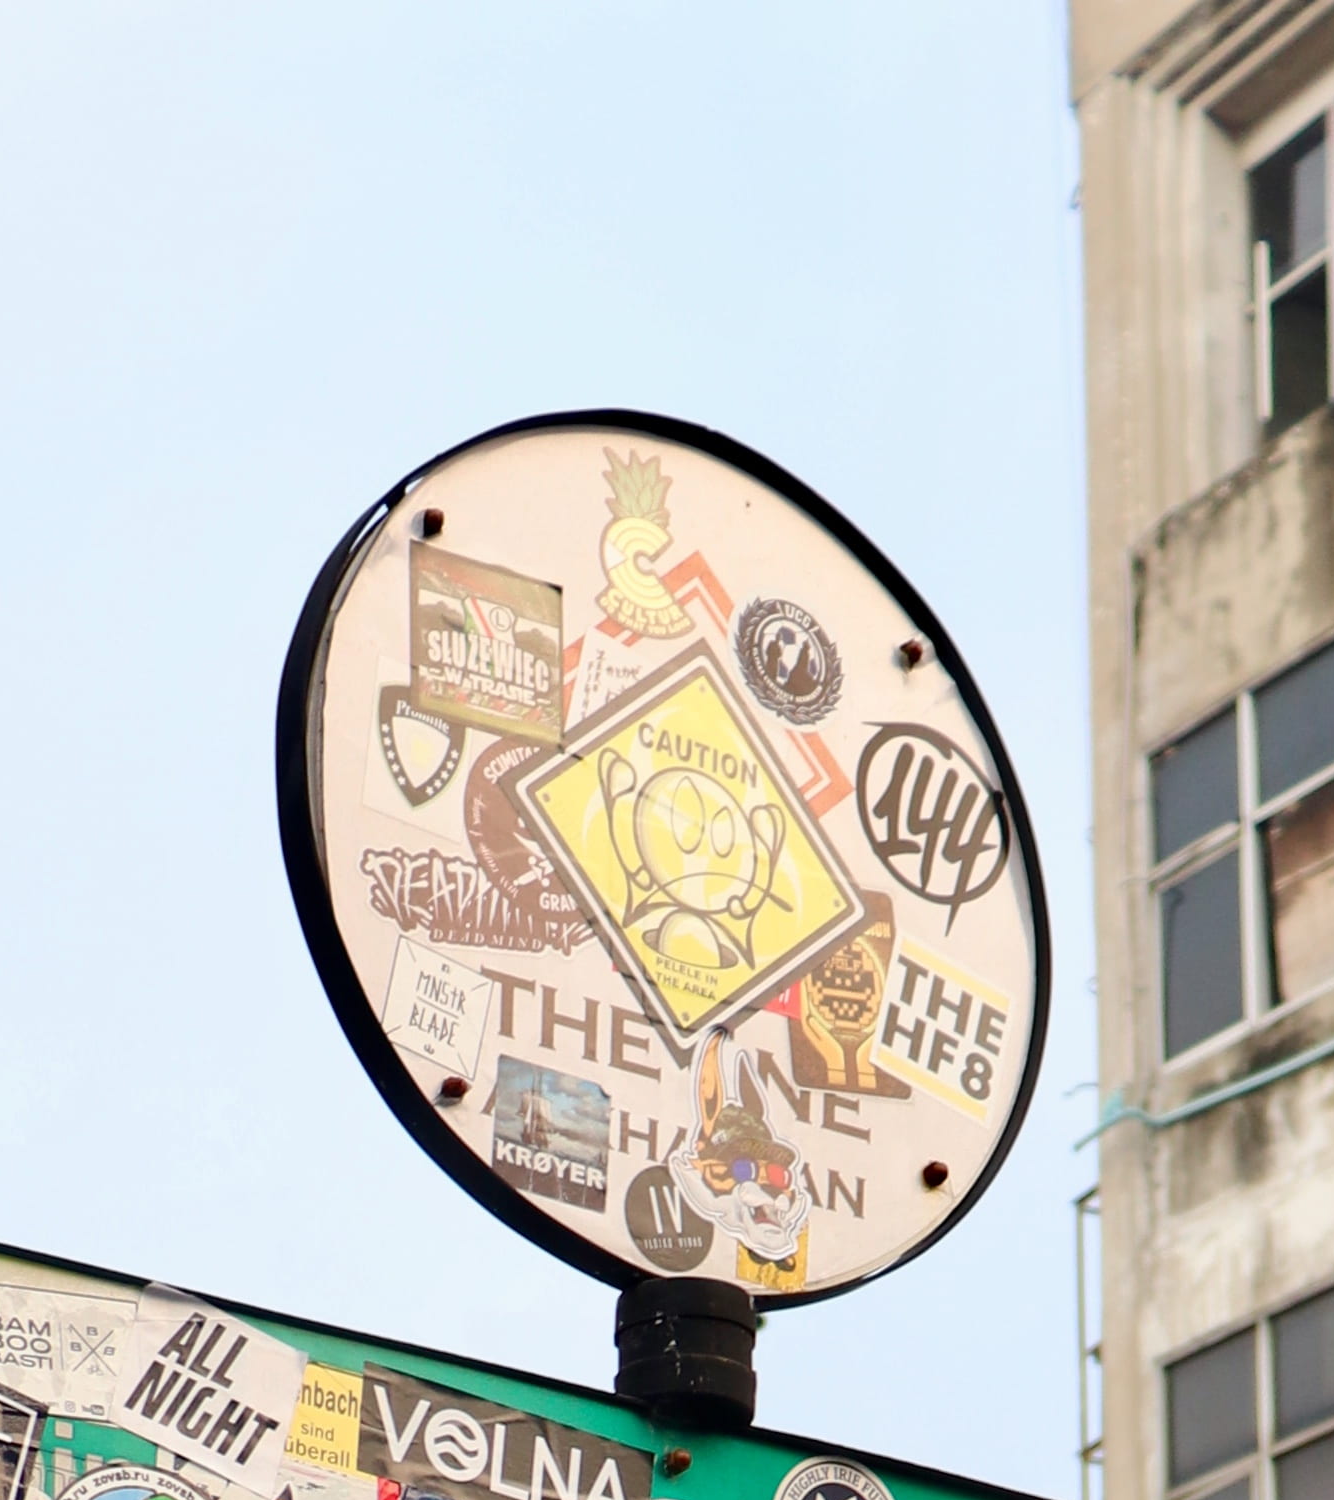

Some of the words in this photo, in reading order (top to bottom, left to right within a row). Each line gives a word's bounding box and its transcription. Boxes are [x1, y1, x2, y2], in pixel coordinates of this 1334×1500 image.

[637, 722, 758, 788] CAUTION
[872, 742, 997, 937] 144
[655, 957, 697, 982] PELELE
[703, 973, 719, 987] IN
[655, 970, 681, 989] THE
[685, 980, 717, 1001] AREA
[896, 954, 1006, 1055] THE
[480, 964, 662, 1082] THE
[880, 1019, 995, 1101] HF8
[496, 1137, 608, 1190] KRØYER
[159, 1311, 250, 1390] ALL
[124, 1361, 279, 1467] NIGHT
[300, 1422, 335, 1442] sind
[789, 1467, 829, 1498] HIGHLY
[833, 1466, 861, 1485] IRIE
